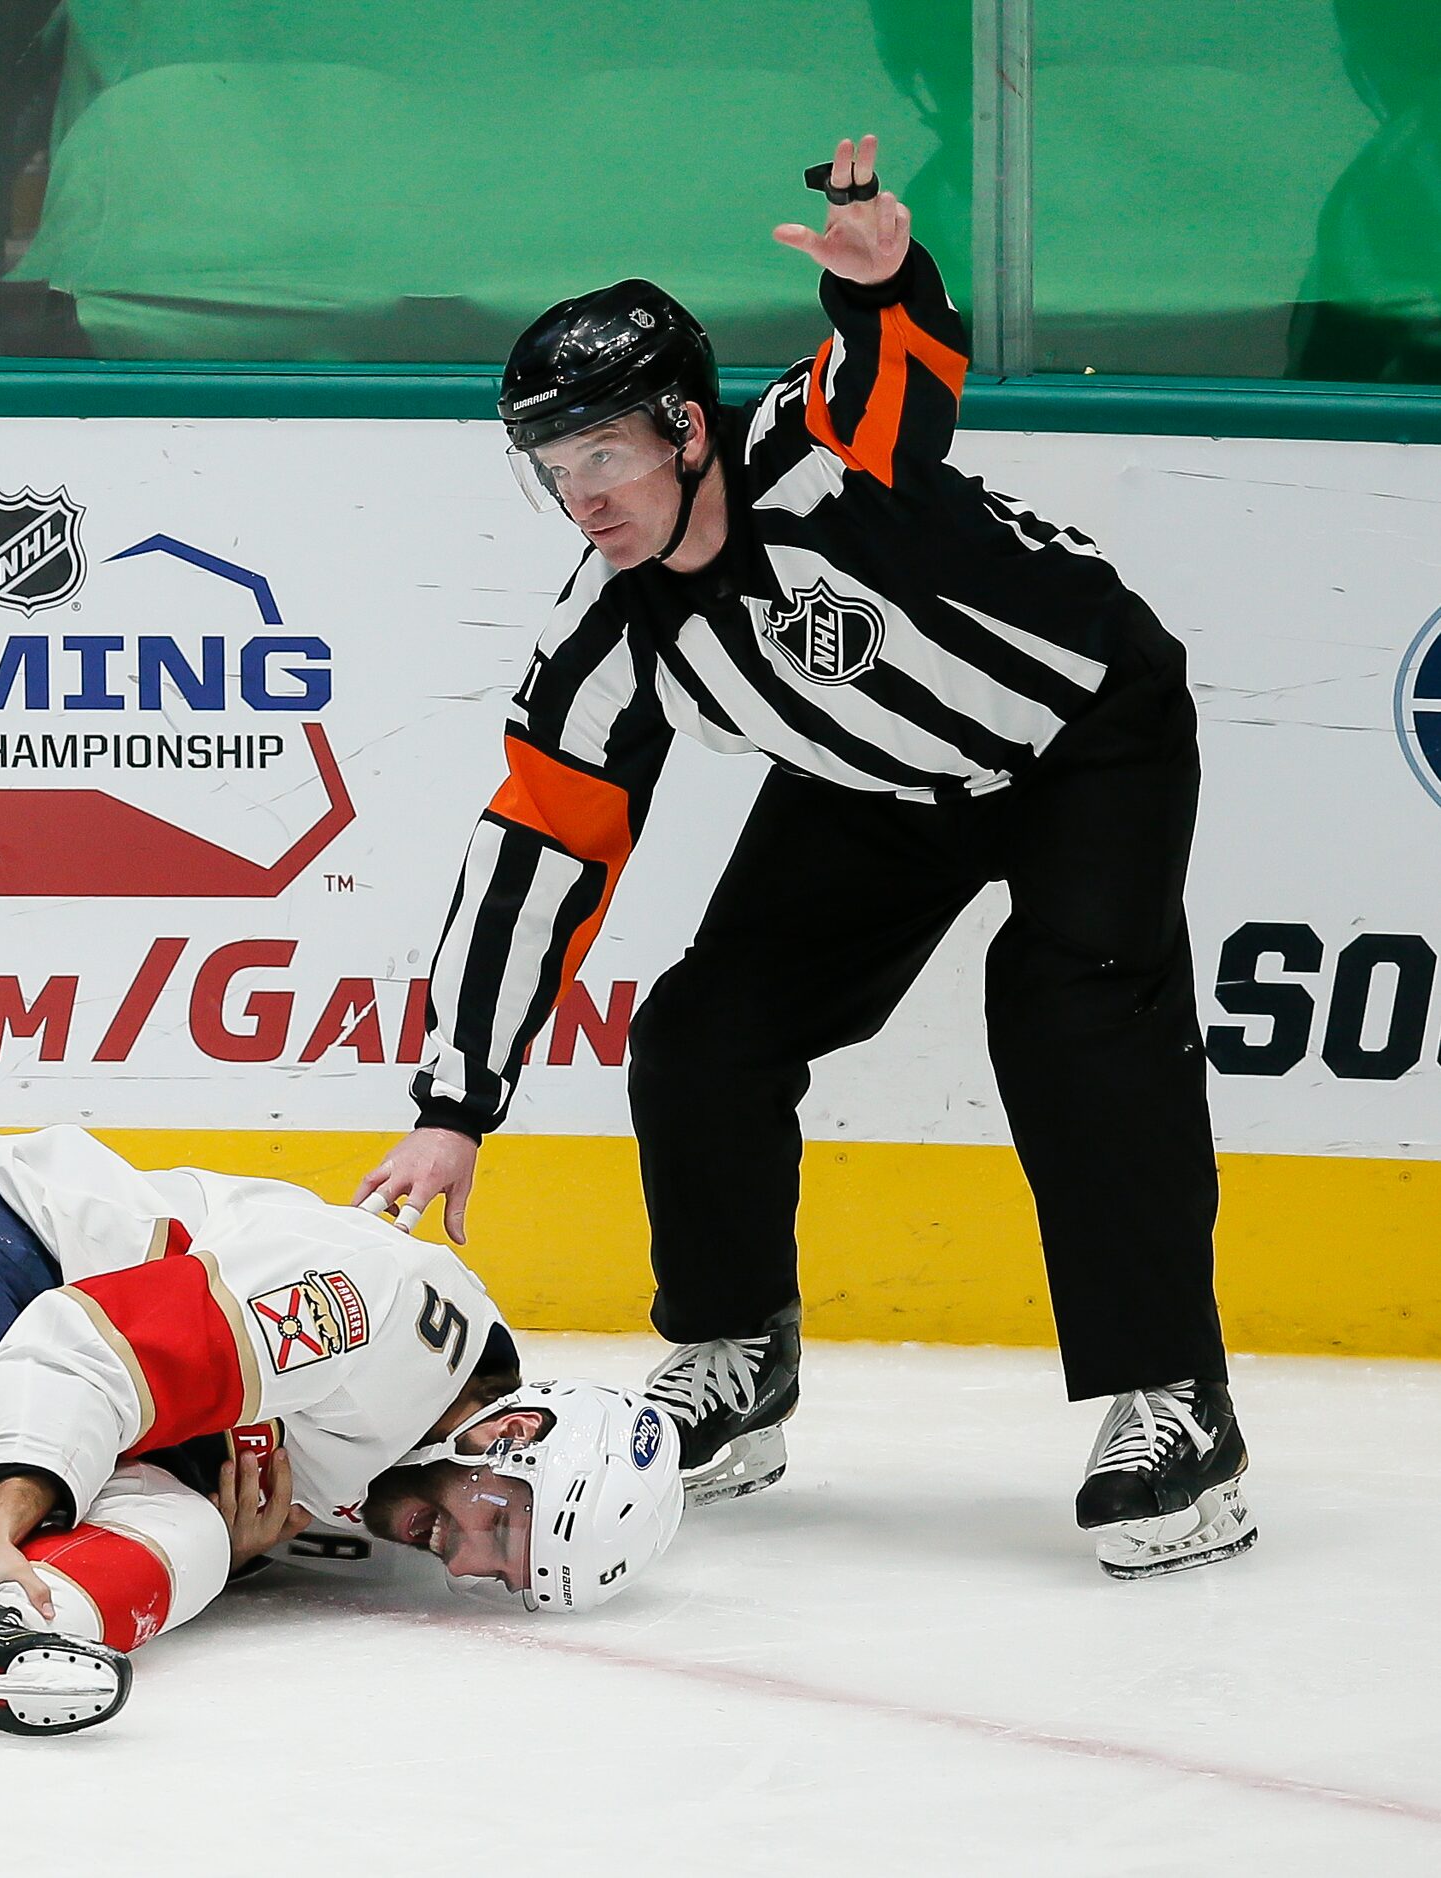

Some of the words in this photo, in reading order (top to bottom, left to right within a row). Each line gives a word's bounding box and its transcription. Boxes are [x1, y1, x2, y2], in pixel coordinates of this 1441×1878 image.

[512, 388, 558, 412] WARRIOR
[812, 611, 836, 673] NHL
[1206, 921, 1441, 1080] SO
[332, 1280, 363, 1338] PANTHERS
[415, 1279, 469, 1376] 5
[633, 1414, 661, 1459] Ford
[599, 1557, 628, 1586] 5
